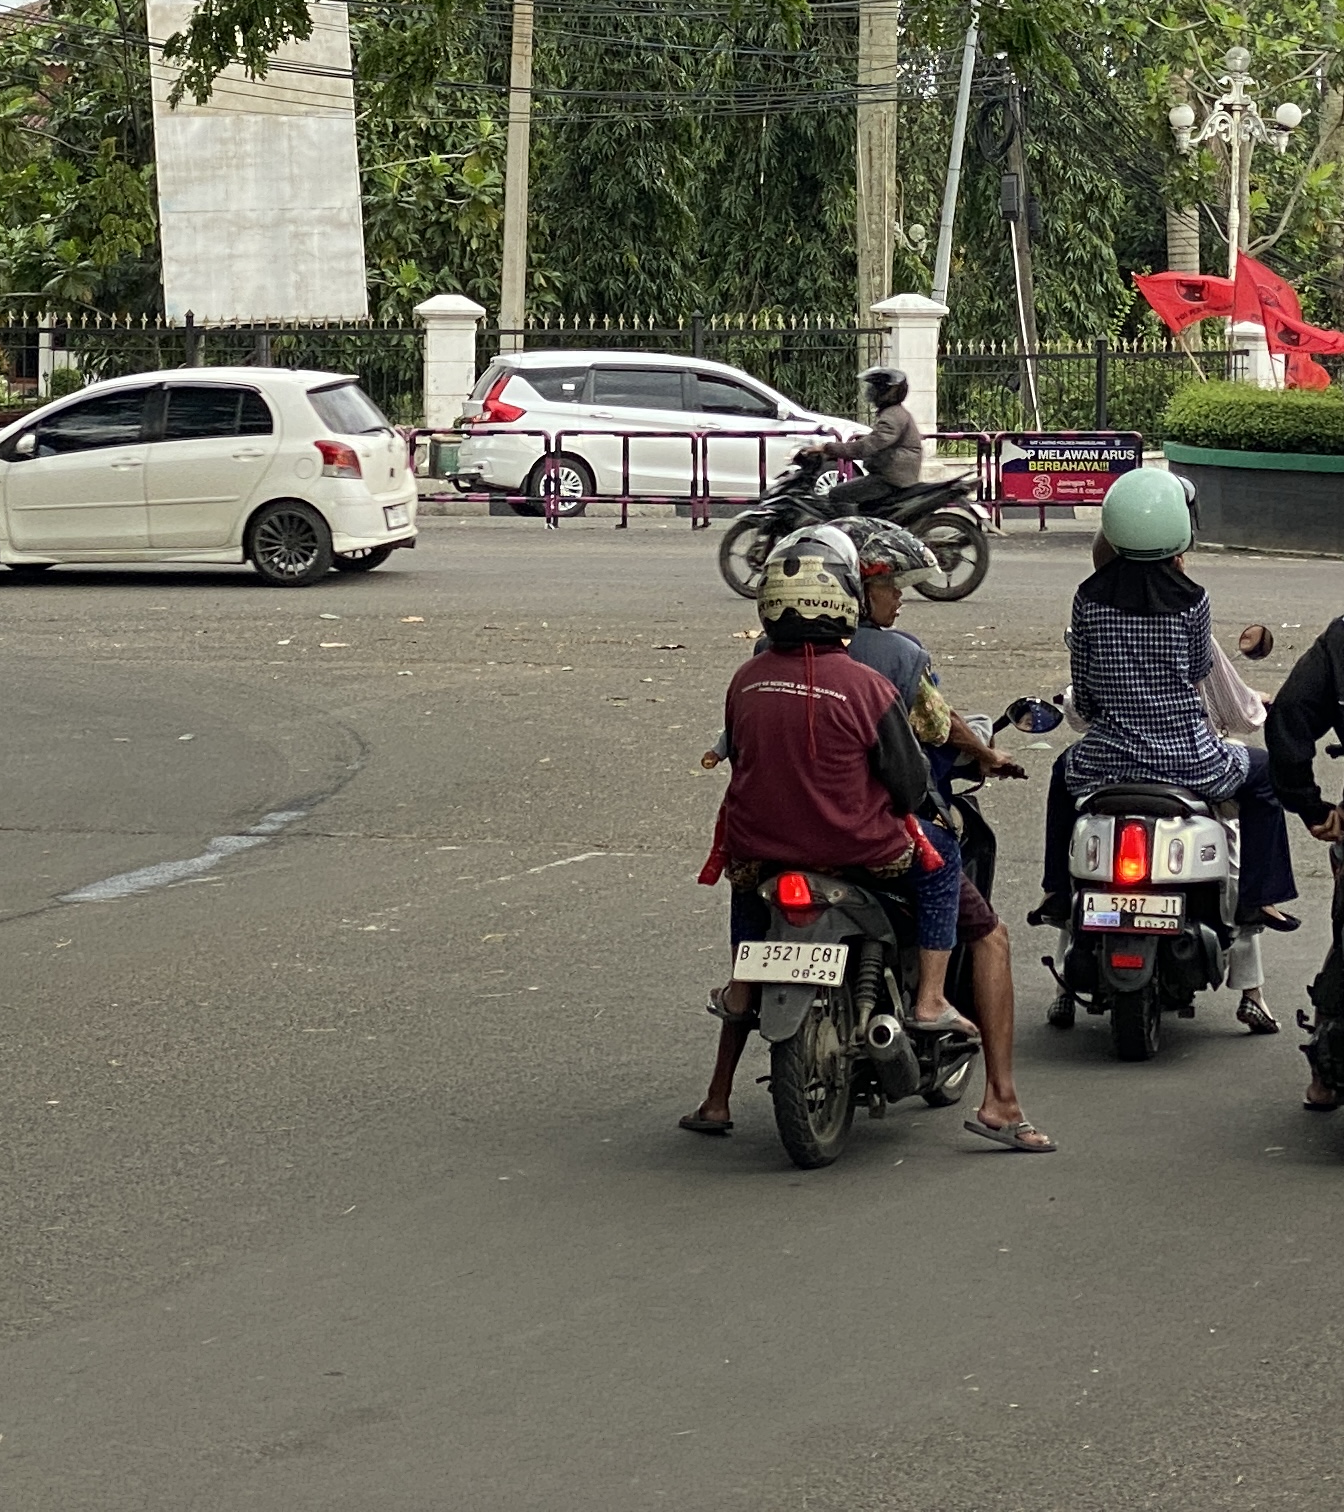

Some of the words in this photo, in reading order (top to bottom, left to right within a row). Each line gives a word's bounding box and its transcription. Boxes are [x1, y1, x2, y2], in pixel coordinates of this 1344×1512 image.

[1038, 450, 1099, 460] MELAWAN
[1101, 450, 1135, 460] ARUS
[1029, 461, 1109, 472] BERBAHAYA!!!
[1086, 897, 1094, 911] A
[1111, 897, 1146, 913] 5287
[1161, 899, 1177, 914] JI
[740, 945, 750, 960] B
[762, 946, 801, 961] 3521
